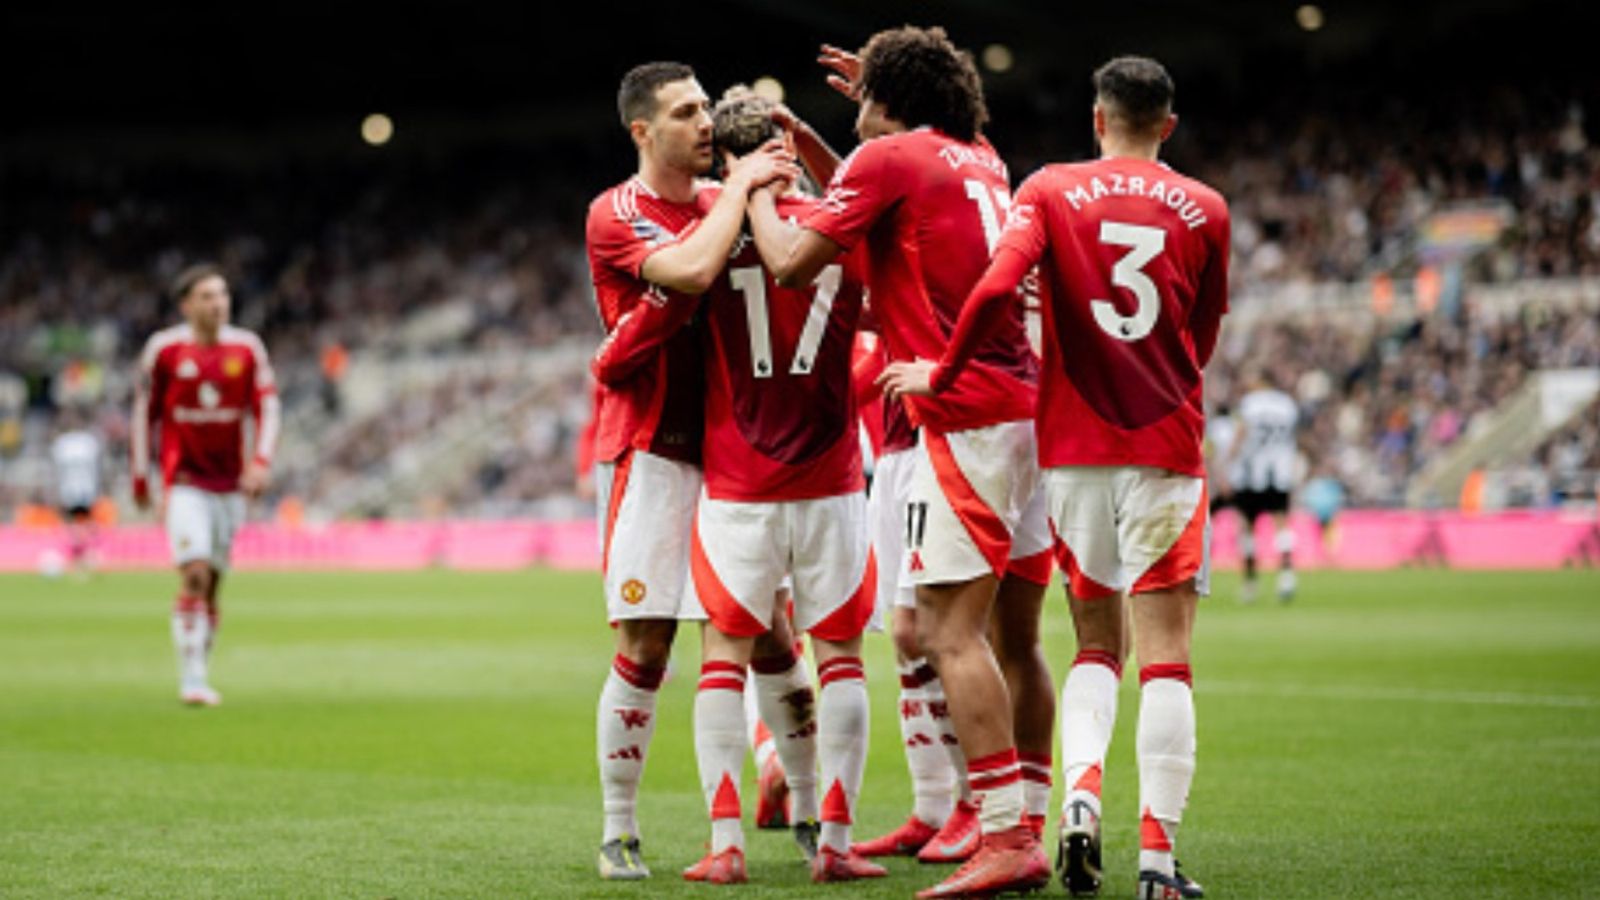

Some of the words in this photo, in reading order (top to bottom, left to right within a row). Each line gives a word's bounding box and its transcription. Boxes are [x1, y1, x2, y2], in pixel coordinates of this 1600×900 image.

[1065, 174, 1207, 230] MAZRAOUI
[729, 264, 843, 378] 17
[1090, 219, 1167, 342] 3
